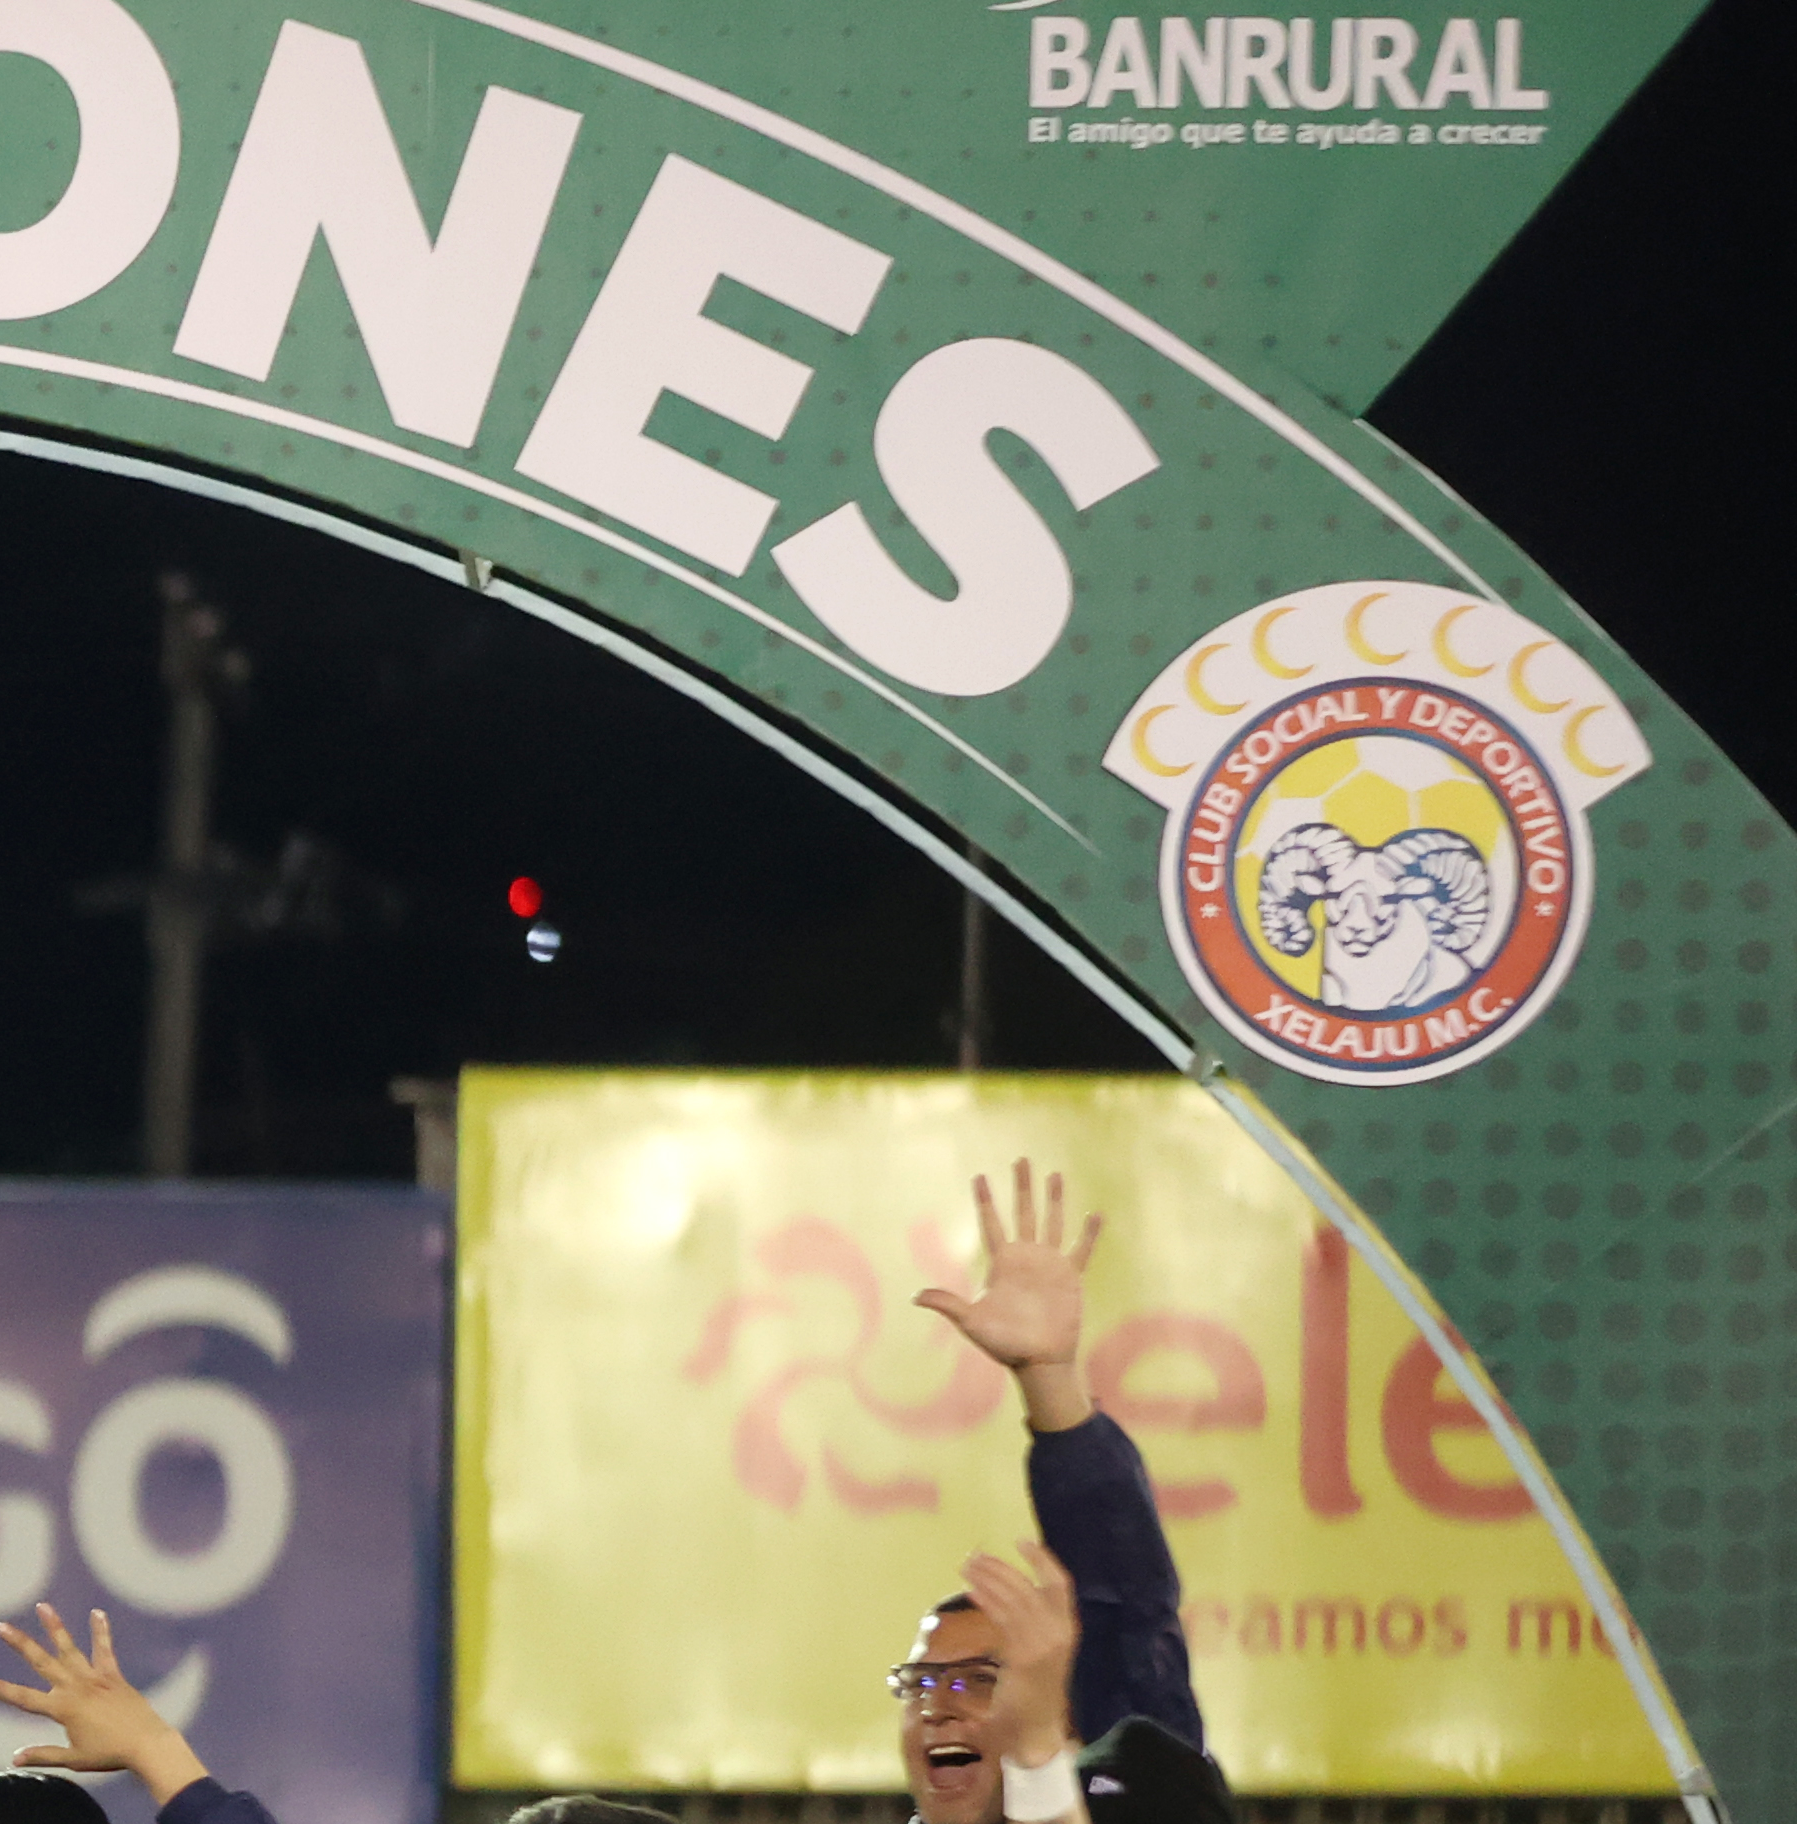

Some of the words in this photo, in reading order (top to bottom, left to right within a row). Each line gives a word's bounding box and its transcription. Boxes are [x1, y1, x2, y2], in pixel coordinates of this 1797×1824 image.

[1027, 15, 1550, 111] BANRURAL
[1027, 116, 1062, 144] El
[1066, 116, 1174, 150] amigo
[1180, 122, 1245, 150] que
[1252, 118, 1289, 145] te
[1295, 118, 1400, 152] ayuda
[1406, 124, 1433, 146] a
[1437, 123, 1548, 147] crecer
[1186, 780, 1243, 892] CLUB
[1225, 690, 1370, 784] SOCIAL
[1375, 687, 1408, 720] Y
[1408, 693, 1566, 895] DEPORTIVO
[1252, 993, 1421, 1059] XELAJU
[1425, 986, 1516, 1049] M.C.
